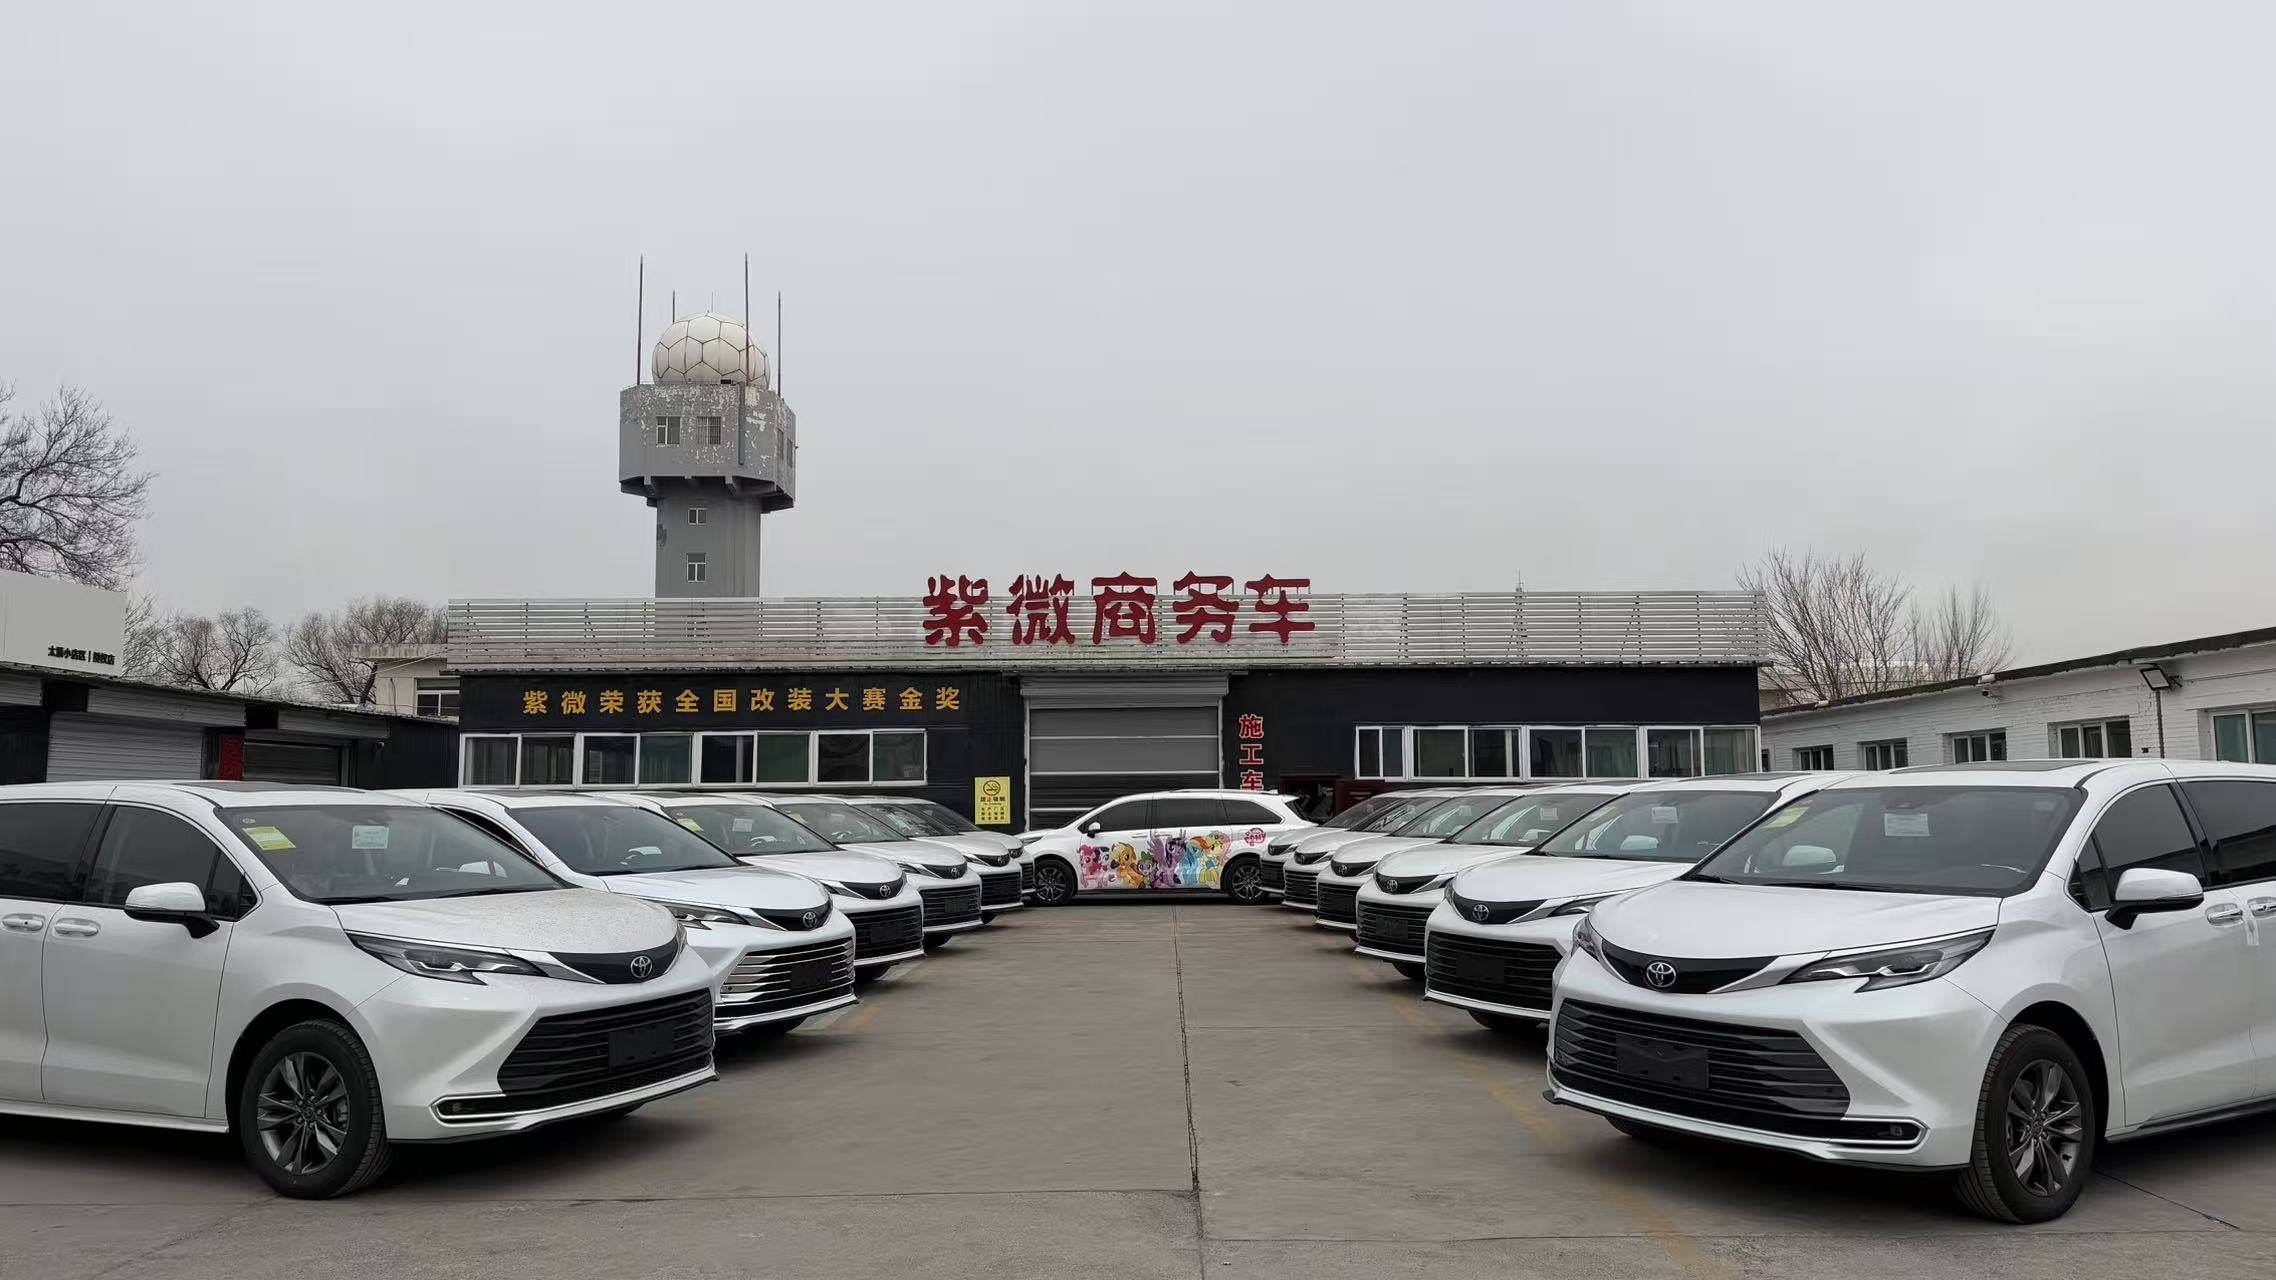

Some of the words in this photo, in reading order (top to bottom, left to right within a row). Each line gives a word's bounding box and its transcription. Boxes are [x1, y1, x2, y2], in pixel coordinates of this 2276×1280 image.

[922, 570, 1315, 647] 紫微商务车
[523, 687, 960, 715] 紫微荣获全国改装大赛金奖
[1239, 714, 1264, 791] 施工车
